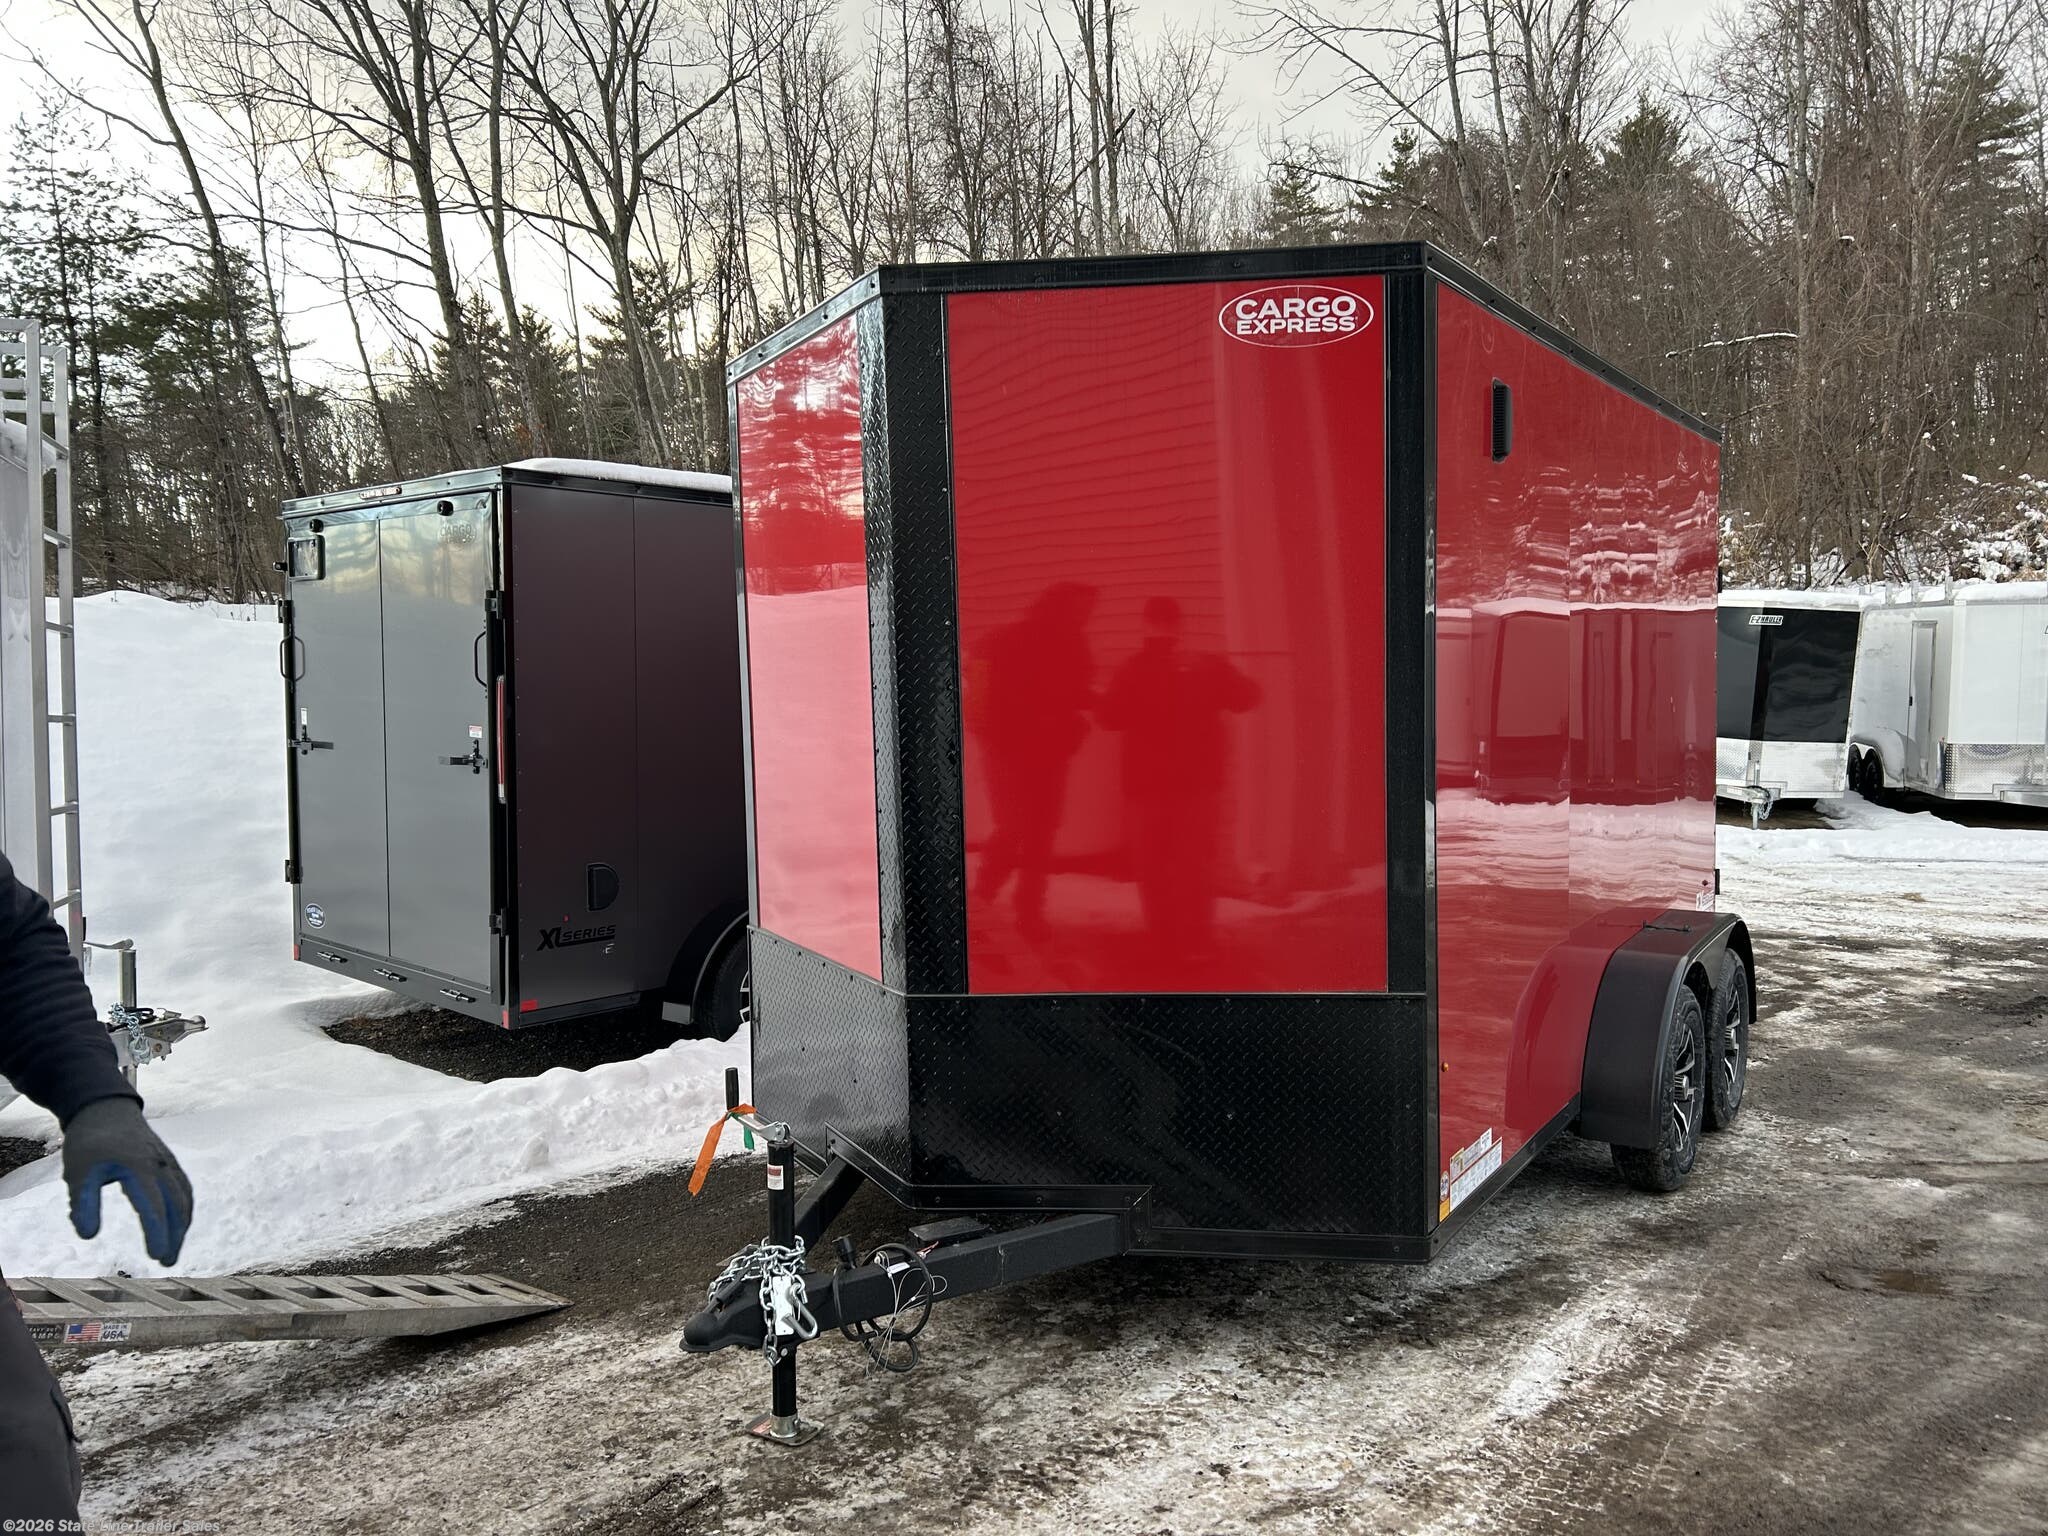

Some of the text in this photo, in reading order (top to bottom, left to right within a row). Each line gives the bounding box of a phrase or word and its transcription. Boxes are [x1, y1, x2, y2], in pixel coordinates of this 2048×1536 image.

[1235, 295, 1357, 320] CARGO
[1236, 316, 1356, 335] EXPRESS
[562, 925, 617, 941] SERIES
[103, 1330, 123, 1339] USA
